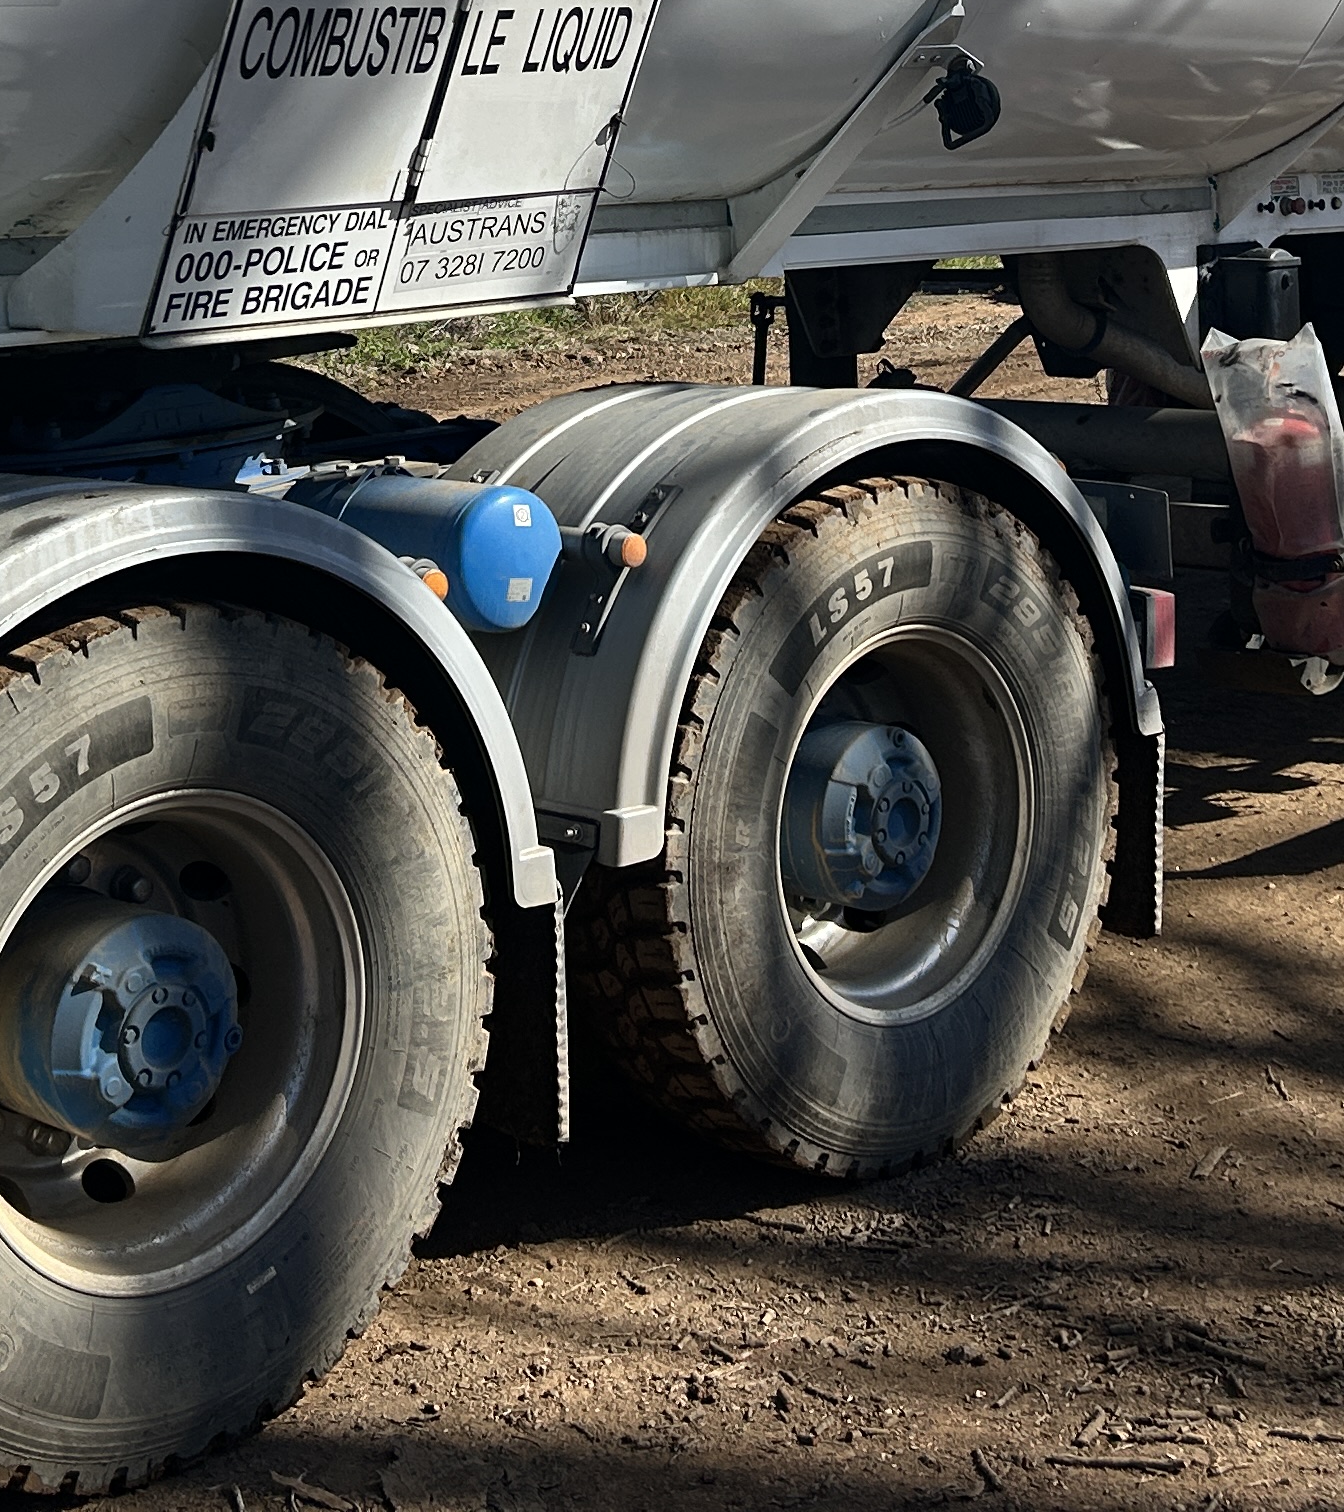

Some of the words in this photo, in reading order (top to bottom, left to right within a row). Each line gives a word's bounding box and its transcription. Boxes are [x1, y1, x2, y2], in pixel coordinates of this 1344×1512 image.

[521, 6, 633, 75] LIQUID
[184, 222, 206, 243] IN
[212, 212, 339, 242] EMERGENCY
[344, 207, 388, 231] DIAL
[412, 201, 480, 216] SPECIALIST
[410, 211, 547, 247] AUSTRANS
[175, 241, 348, 284] 000-POLICE
[354, 249, 380, 268] OR
[400, 260, 430, 284] 07
[491, 246, 545, 273] 7200
[162, 290, 230, 323] FIRE
[240, 276, 374, 316] BRIGADE
[809, 556, 895, 647] LS57
